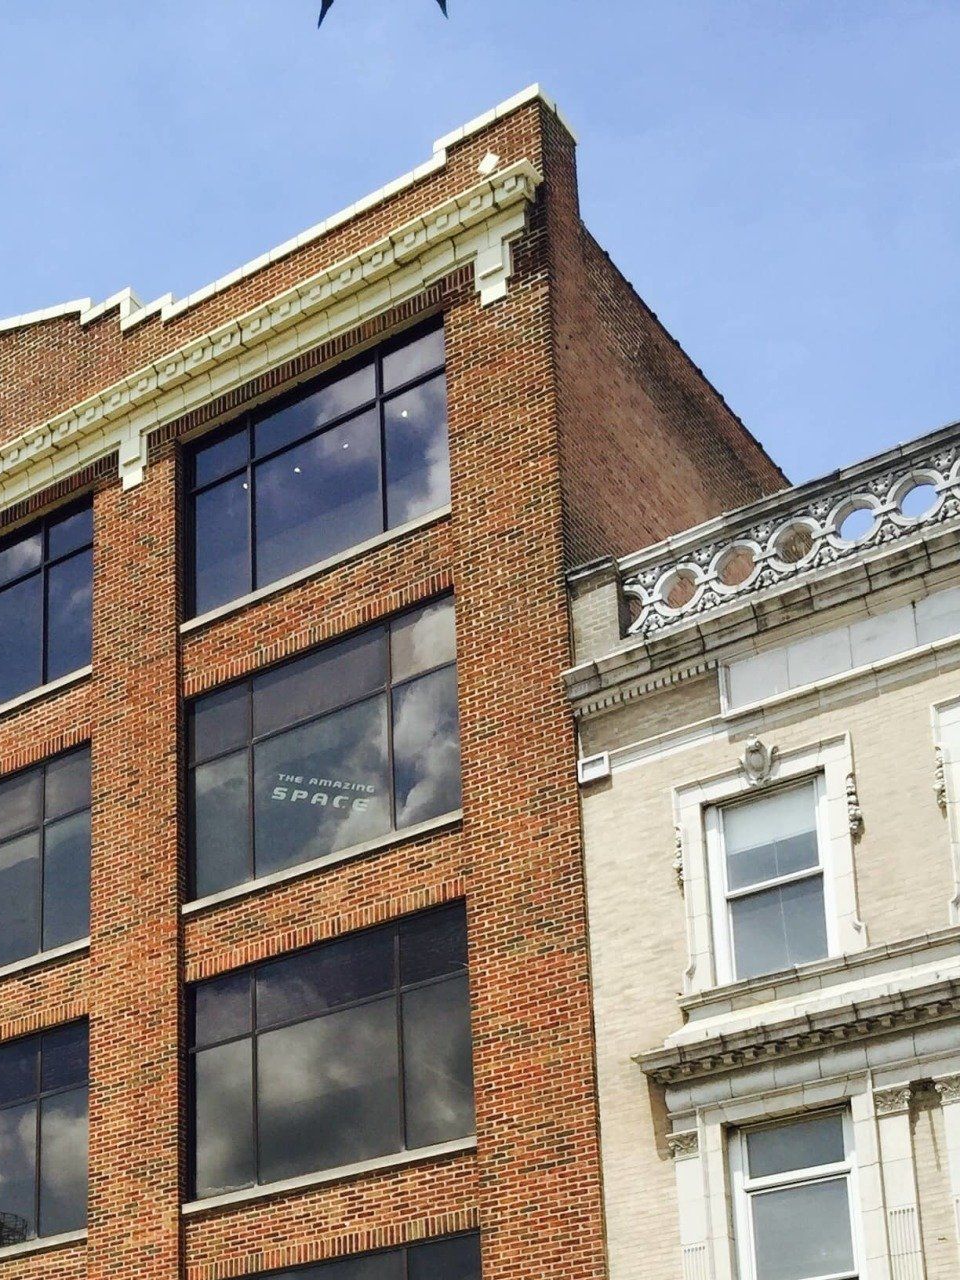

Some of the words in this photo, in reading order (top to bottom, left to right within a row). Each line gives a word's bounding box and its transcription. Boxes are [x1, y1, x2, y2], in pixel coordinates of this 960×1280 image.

[278, 773, 304, 784] THE
[308, 777, 375, 793] AMAZING
[271, 786, 370, 812] SPACE
